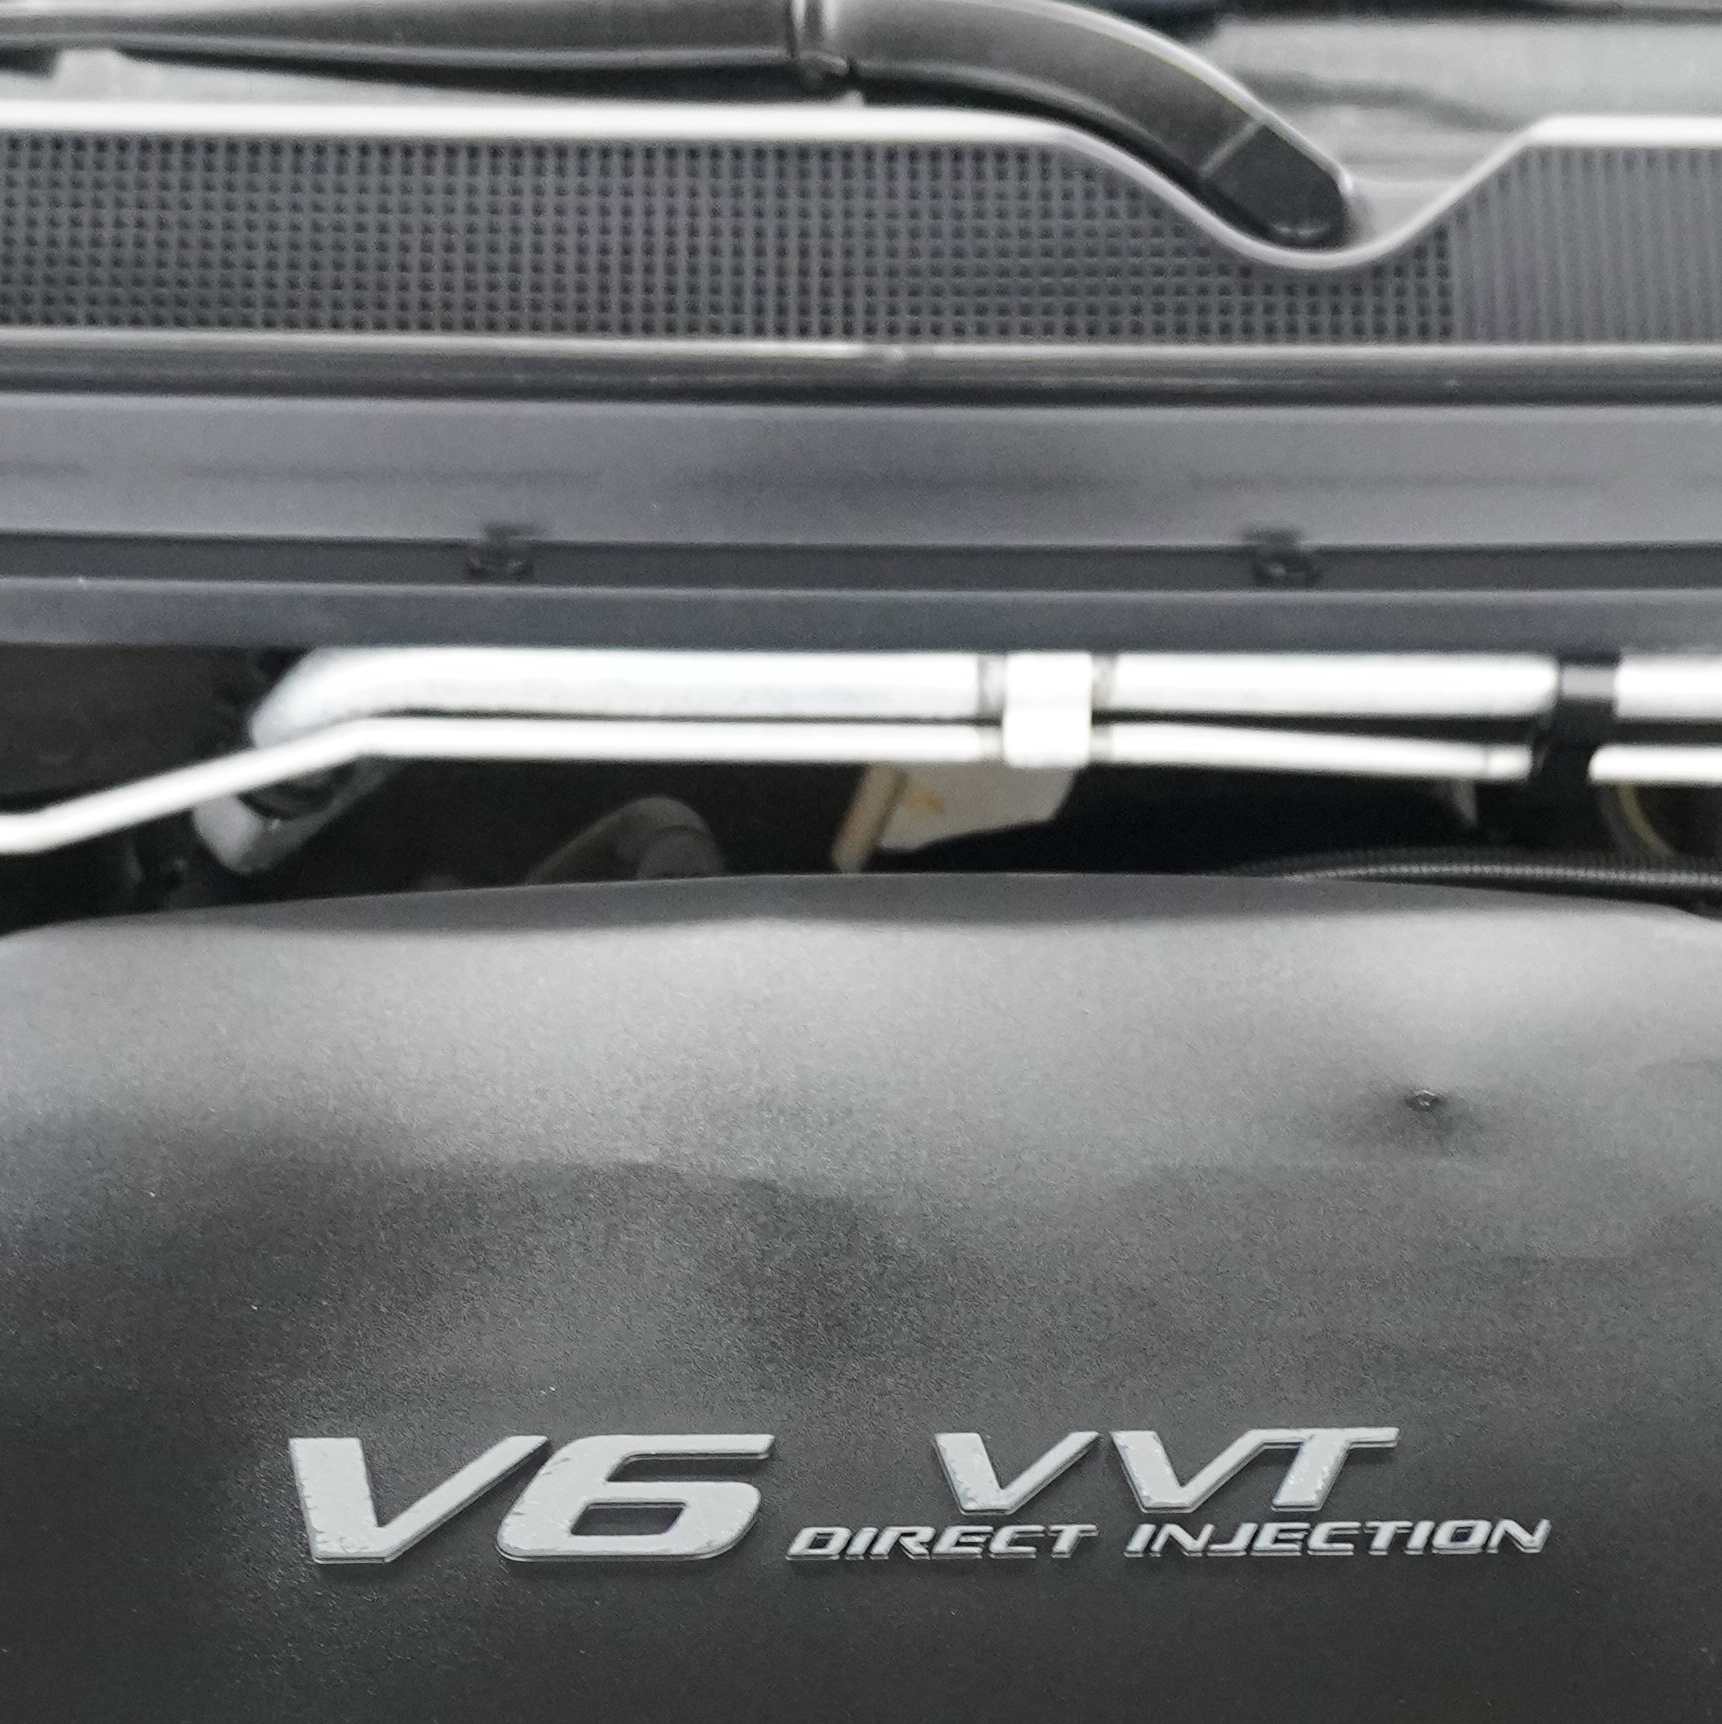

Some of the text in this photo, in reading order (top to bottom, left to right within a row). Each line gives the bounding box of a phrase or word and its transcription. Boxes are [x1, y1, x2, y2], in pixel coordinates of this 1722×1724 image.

[287, 1434, 775, 1564] V6
[933, 1426, 1401, 1515] VVT
[785, 1518, 1552, 1562] DIRECT INJECTION
